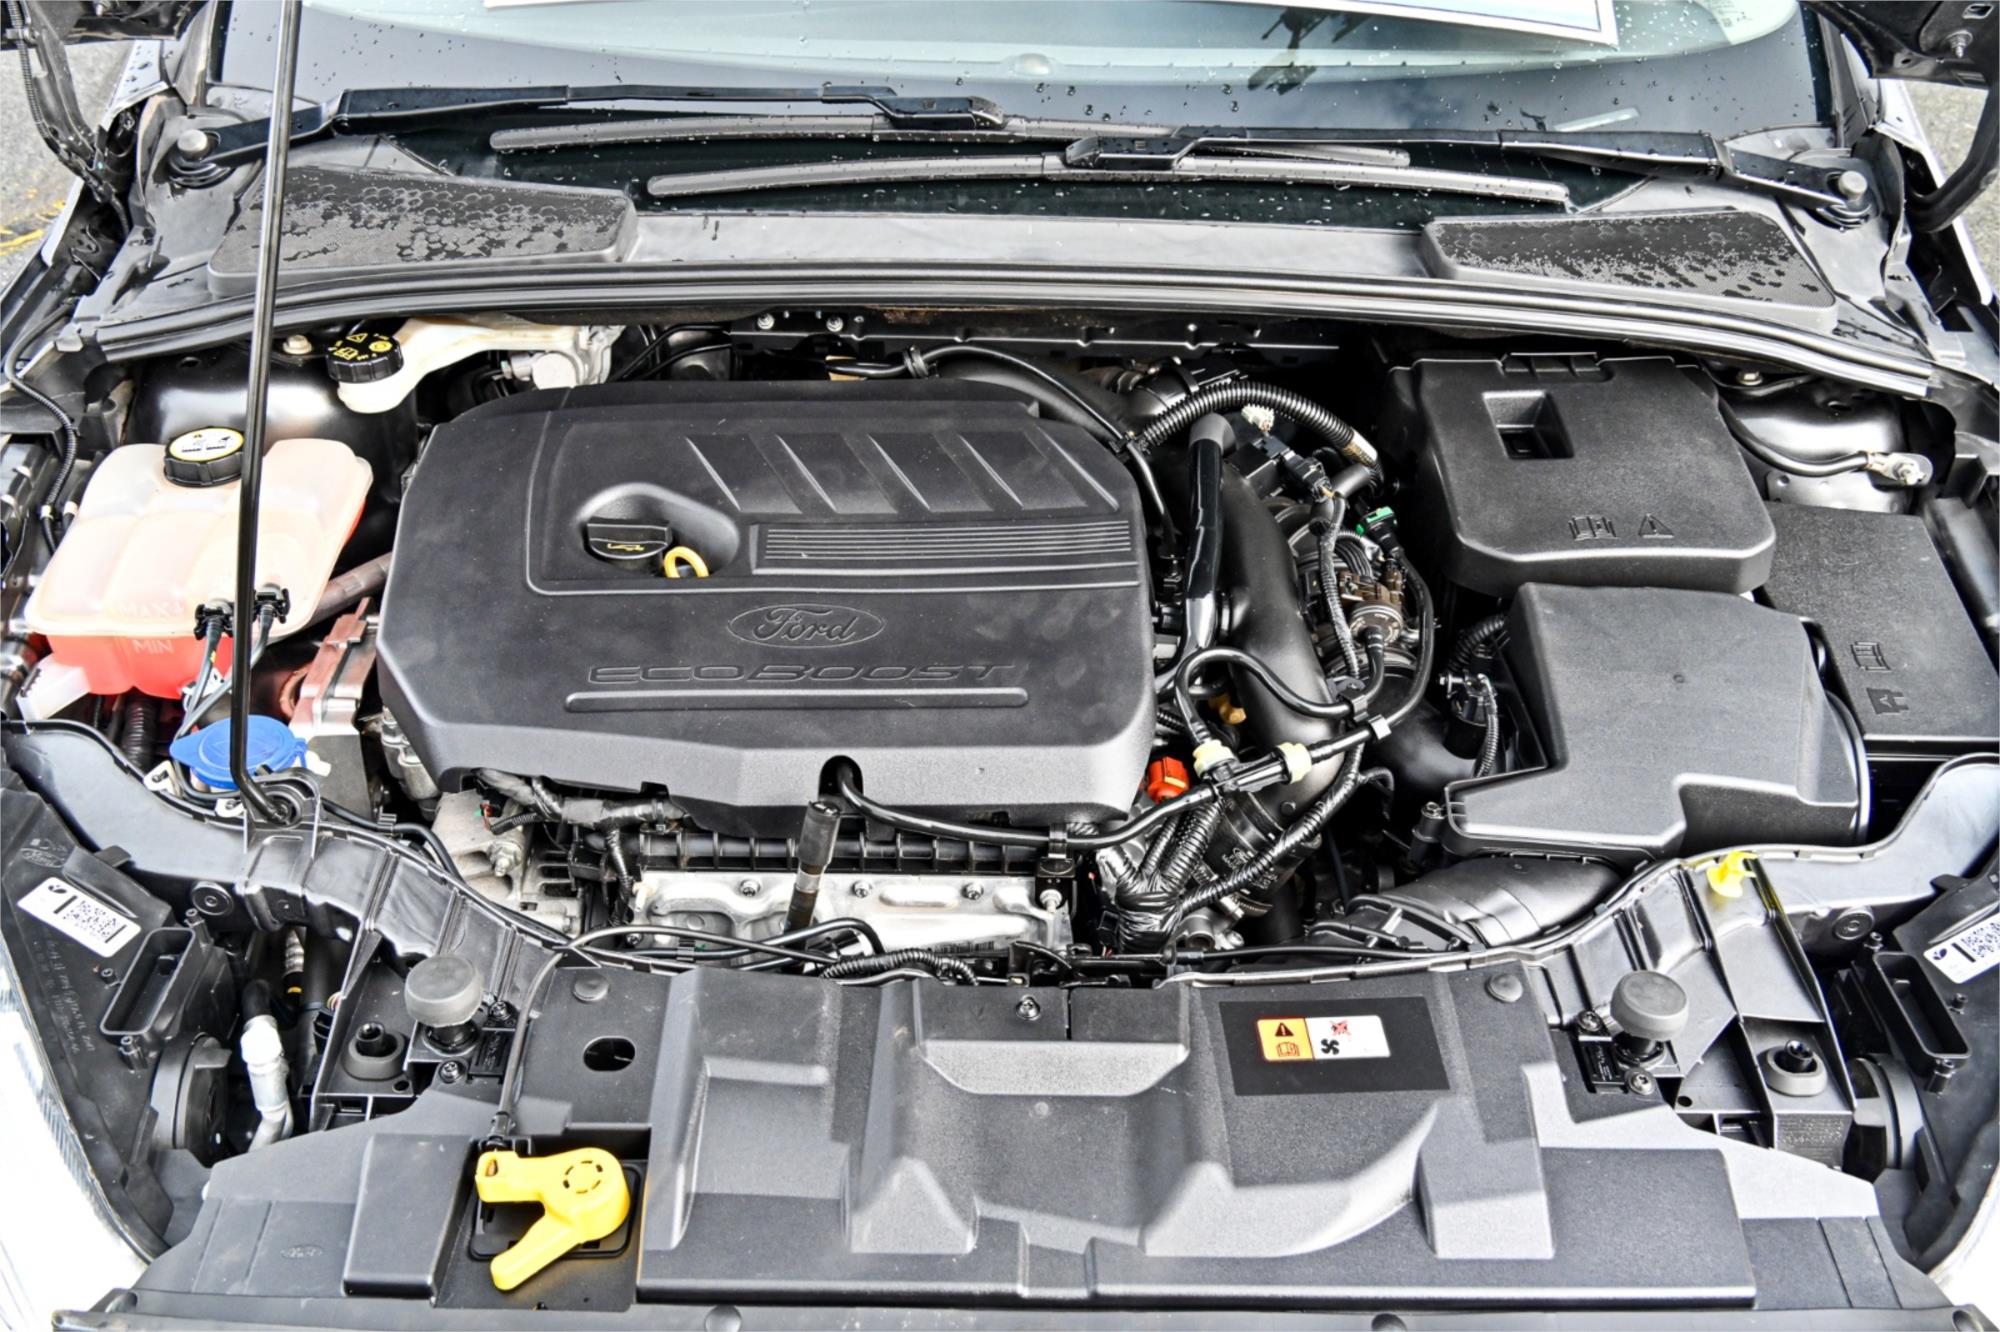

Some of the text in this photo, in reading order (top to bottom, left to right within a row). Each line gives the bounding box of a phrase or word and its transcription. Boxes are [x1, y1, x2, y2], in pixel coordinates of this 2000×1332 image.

[752, 608, 857, 642] Ford
[131, 638, 175, 654] MIN
[588, 664, 1014, 684] ECOBOOST
